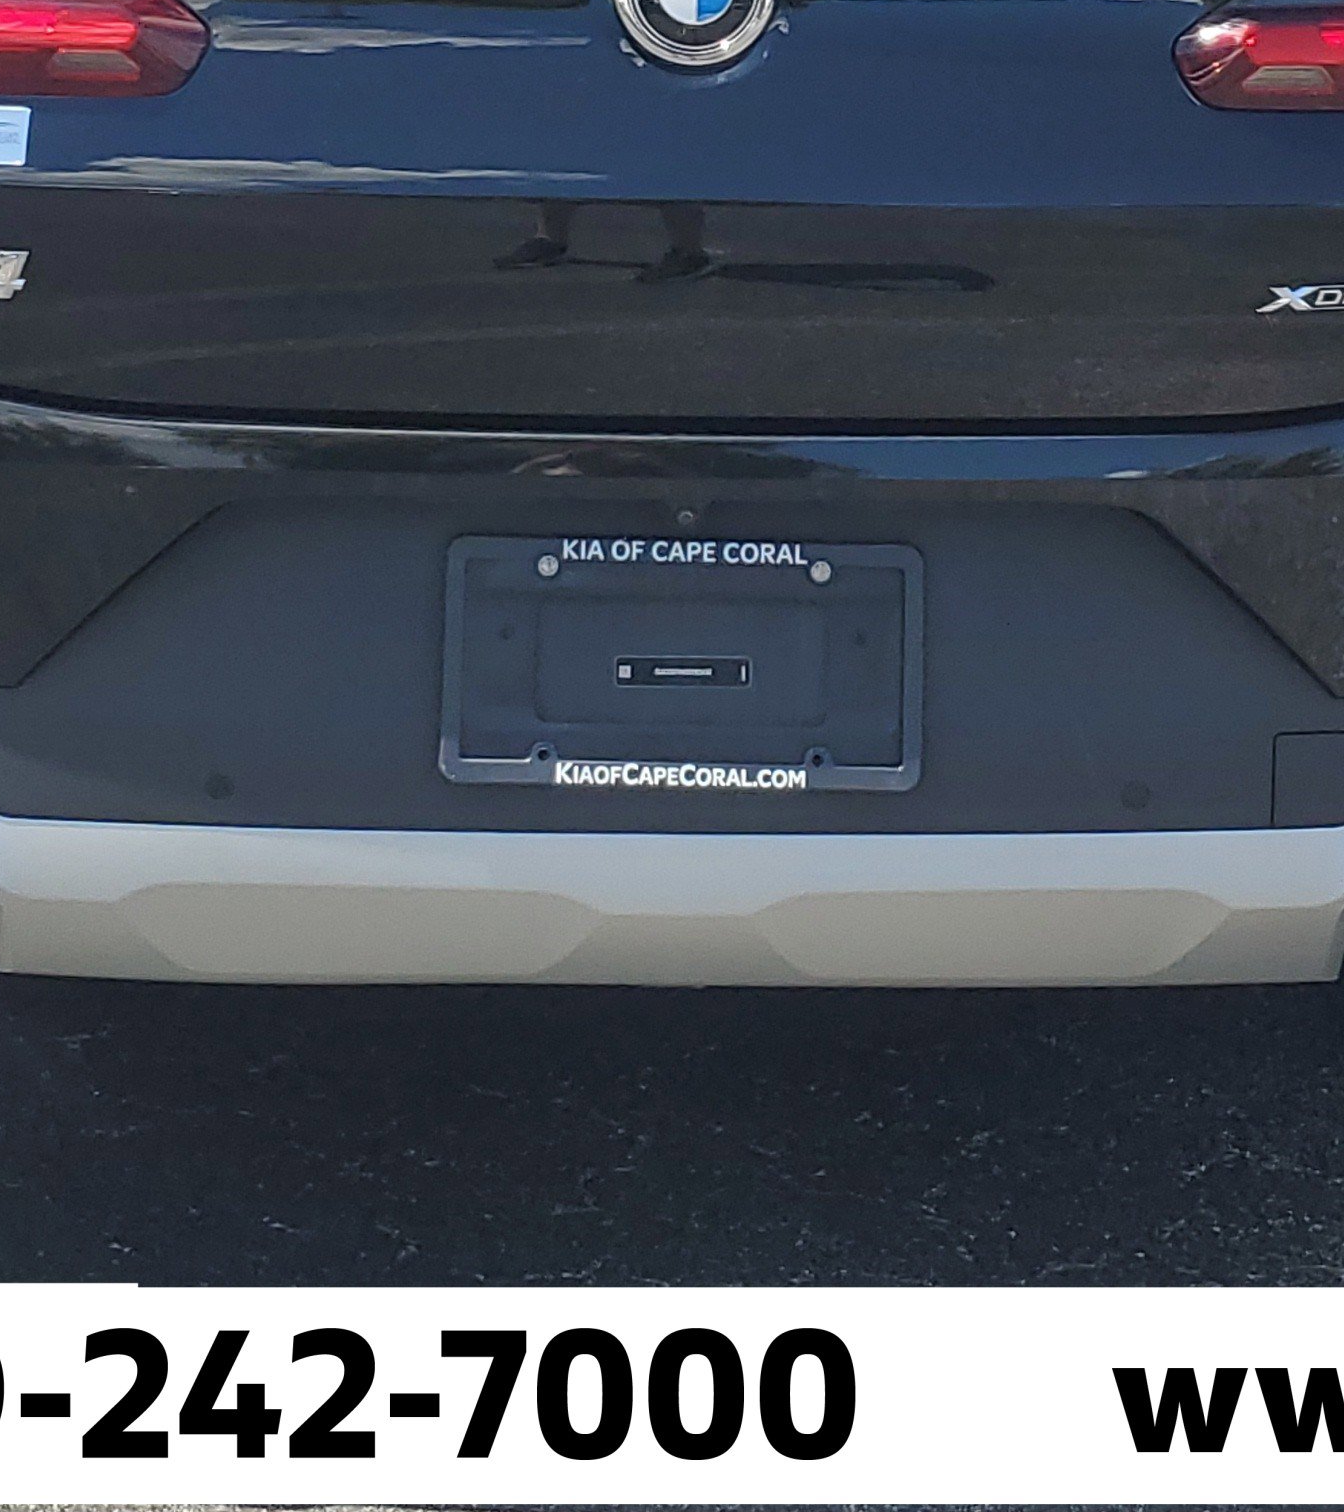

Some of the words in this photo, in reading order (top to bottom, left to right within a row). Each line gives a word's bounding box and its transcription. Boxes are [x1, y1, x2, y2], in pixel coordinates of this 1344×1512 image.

[562, 539, 606, 561] KIA
[610, 540, 646, 562] OF
[651, 541, 718, 564] CAPE
[722, 542, 809, 565] CORAL
